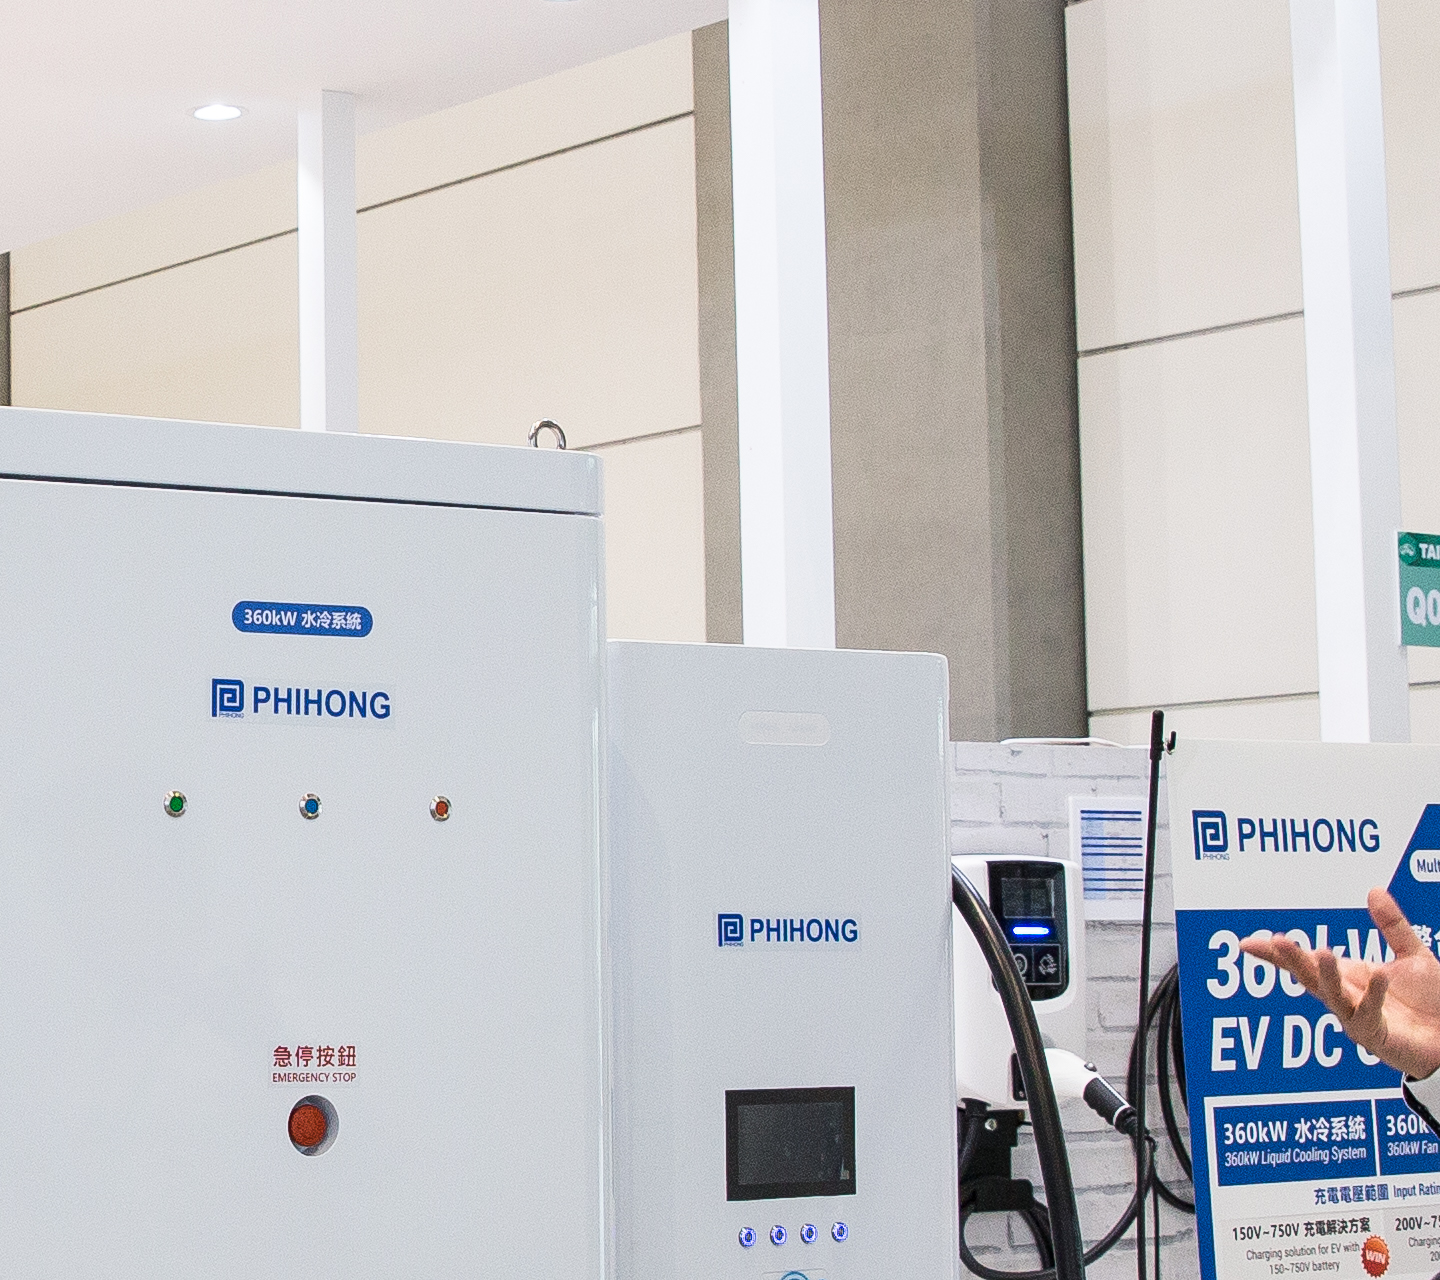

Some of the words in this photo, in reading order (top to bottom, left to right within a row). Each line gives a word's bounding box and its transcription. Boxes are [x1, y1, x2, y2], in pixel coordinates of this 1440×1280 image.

[243, 609, 297, 627] 360kW
[301, 610, 362, 632] 水冷系統
[253, 685, 392, 720] PHIHONG
[1237, 818, 1380, 853] PHIHONG
[750, 918, 858, 942] PHIHONG
[1211, 1015, 1270, 1072] EV
[1282, 1013, 1343, 1070] DC
[273, 1045, 357, 1068] 急停按鈕
[272, 1072, 330, 1083] EMERGENCY
[333, 1072, 357, 1083] STOP
[1223, 1120, 1288, 1145] 360kW
[1294, 1115, 1367, 1143] 水冷系統
[1224, 1151, 1259, 1167] 360kW
[1261, 1148, 1291, 1166] Liquid
[1293, 1145, 1330, 1164] Cooling
[1331, 1144, 1367, 1161] System
[1387, 1140, 1420, 1157] 360kW
[1421, 1141, 1439, 1155] Fan
[1392, 1183, 1418, 1198] Input
[1232, 1221, 1300, 1241] 150V~750V
[1246, 1245, 1283, 1262] Charging
[1284, 1243, 1315, 1258] solution
[1317, 1243, 1328, 1255] for
[1330, 1243, 1341, 1254] EV
[1342, 1241, 1360, 1254] with
[1365, 1250, 1387, 1264] WIN
[1269, 1262, 1310, 1276] 150~750V
[1312, 1260, 1340, 1275] battery
